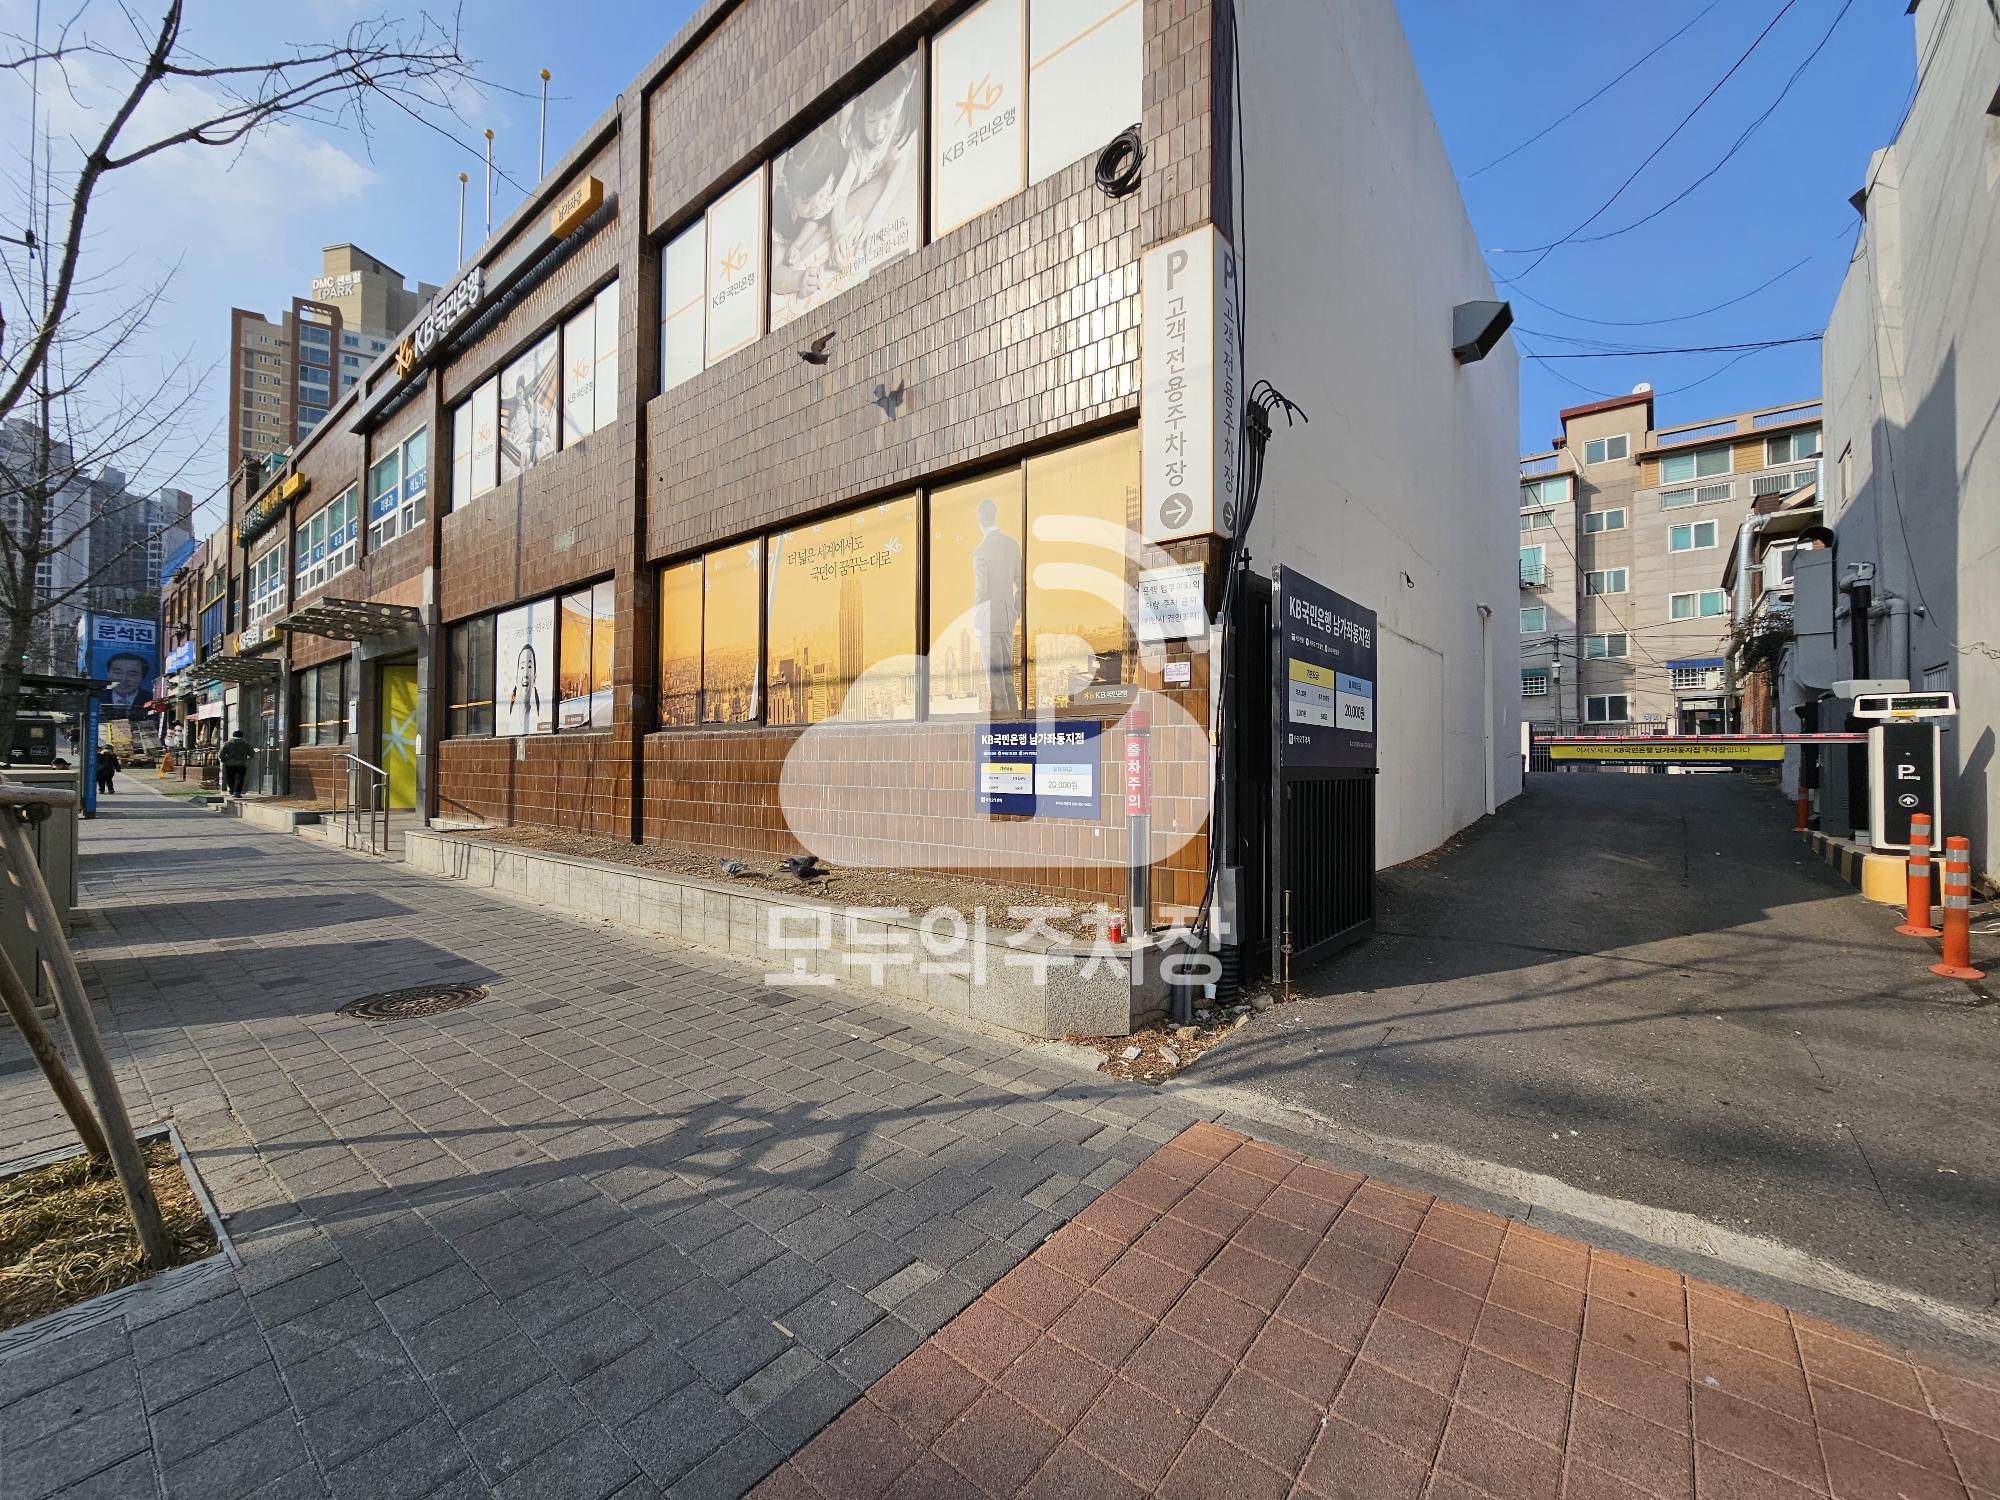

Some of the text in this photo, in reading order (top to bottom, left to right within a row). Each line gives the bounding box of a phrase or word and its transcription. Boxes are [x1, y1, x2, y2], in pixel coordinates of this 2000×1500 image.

[313, 276, 335, 290] DMC
[1164, 249, 1188, 487] P 고객전용주차장
[788, 551, 797, 566] 더
[817, 535, 865, 560] 세계에서도
[810, 561, 837, 582] 국민이
[839, 556, 870, 577] 꿈꾸는
[98, 624, 153, 642] 문석진
[1289, 595, 1331, 633] KB국민은행
[1333, 614, 1371, 649] 남가좌동지점
[981, 731, 1085, 746] KB국민은행 남가좌동지점
[1654, 746, 1701, 754] 남가좌동지점
[1127, 742, 1141, 809] 출차주의
